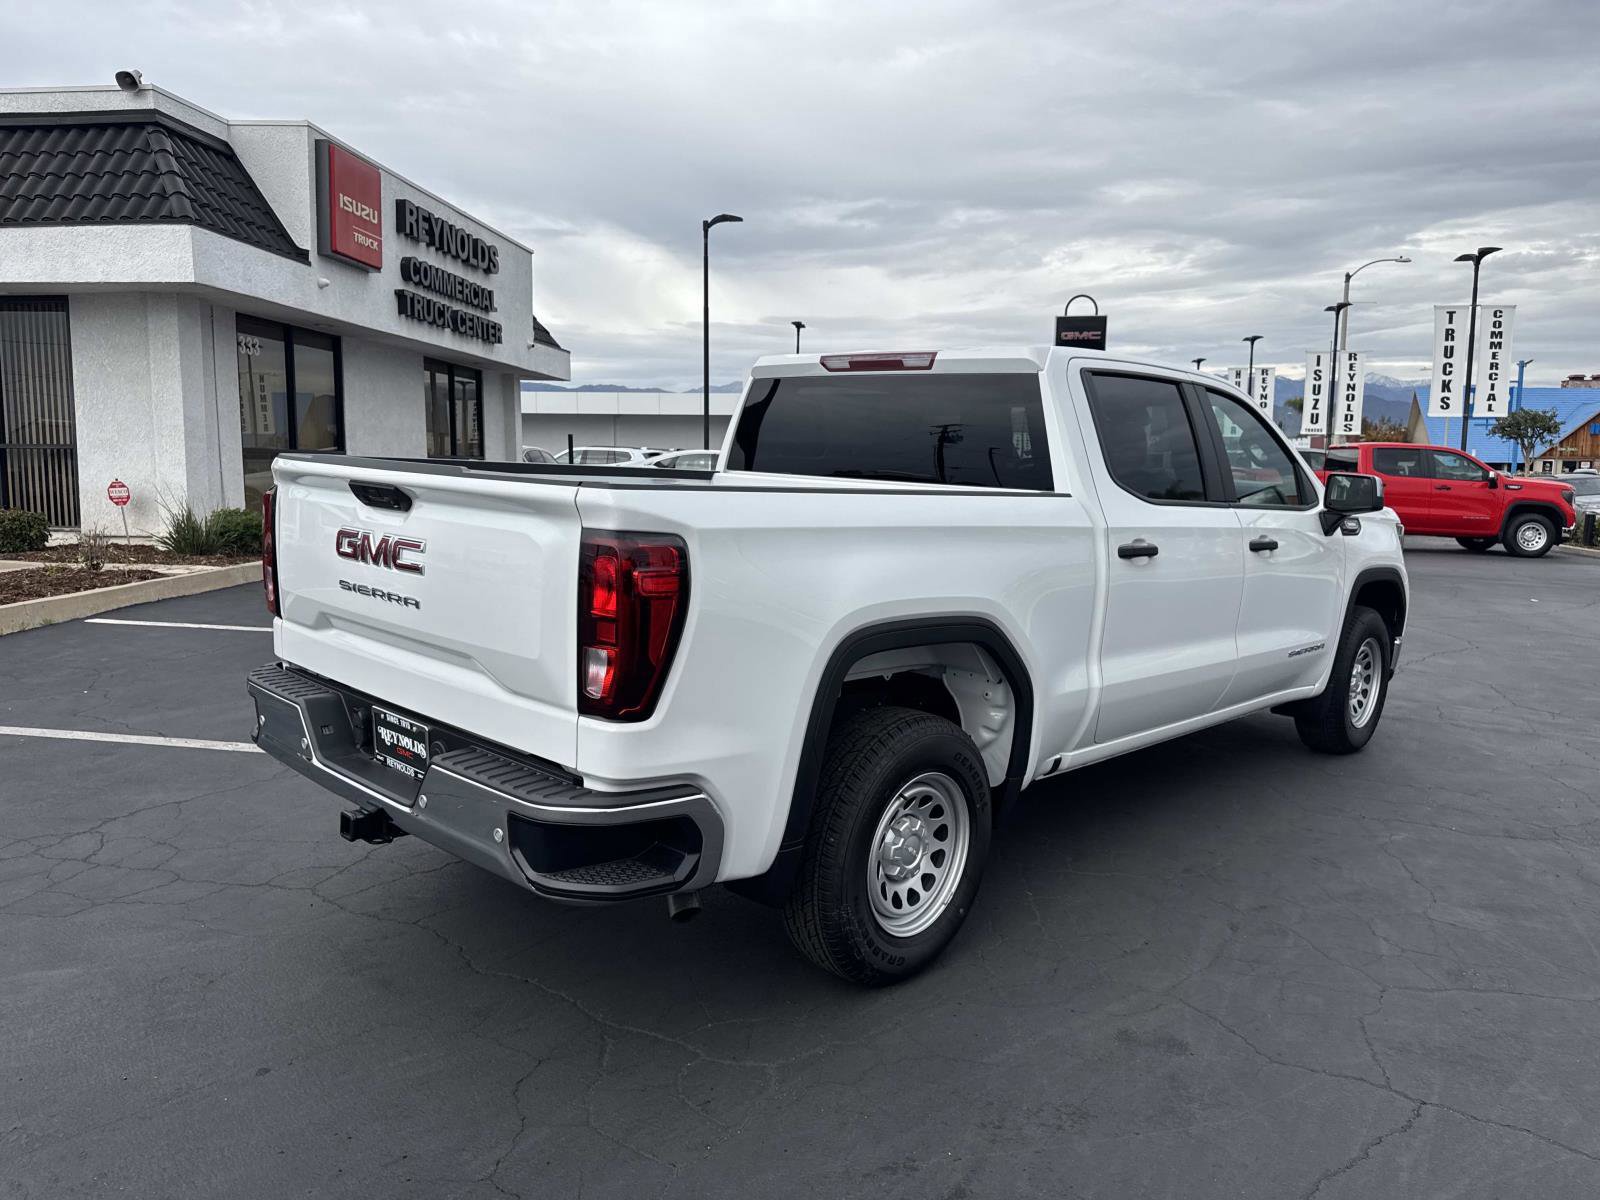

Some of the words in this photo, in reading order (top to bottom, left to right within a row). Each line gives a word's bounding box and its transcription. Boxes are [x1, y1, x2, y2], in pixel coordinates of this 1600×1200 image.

[339, 192, 378, 224] ISUZU
[353, 231, 379, 251] TRUCK
[396, 199, 499, 274] REYNOLDS
[400, 256, 497, 312] COMMERCIAL
[395, 289, 453, 328] TRUCK
[452, 309, 502, 344] CENTER
[239, 335, 261, 355] 333
[1061, 331, 1101, 340] GMC
[1439, 310, 1457, 411] TRUCKS
[1486, 309, 1503, 412] COMMERCIAL
[1310, 354, 1322, 425] ISUZU
[1343, 352, 1358, 432] REYNOLDS
[336, 526, 426, 577] GMC
[339, 579, 420, 610] SIERRA
[1288, 643, 1325, 658] SIERRA
[377, 725, 427, 759] REYNOLDS
[396, 747, 414, 760] GMC
[386, 758, 415, 777] REYNOLDS
